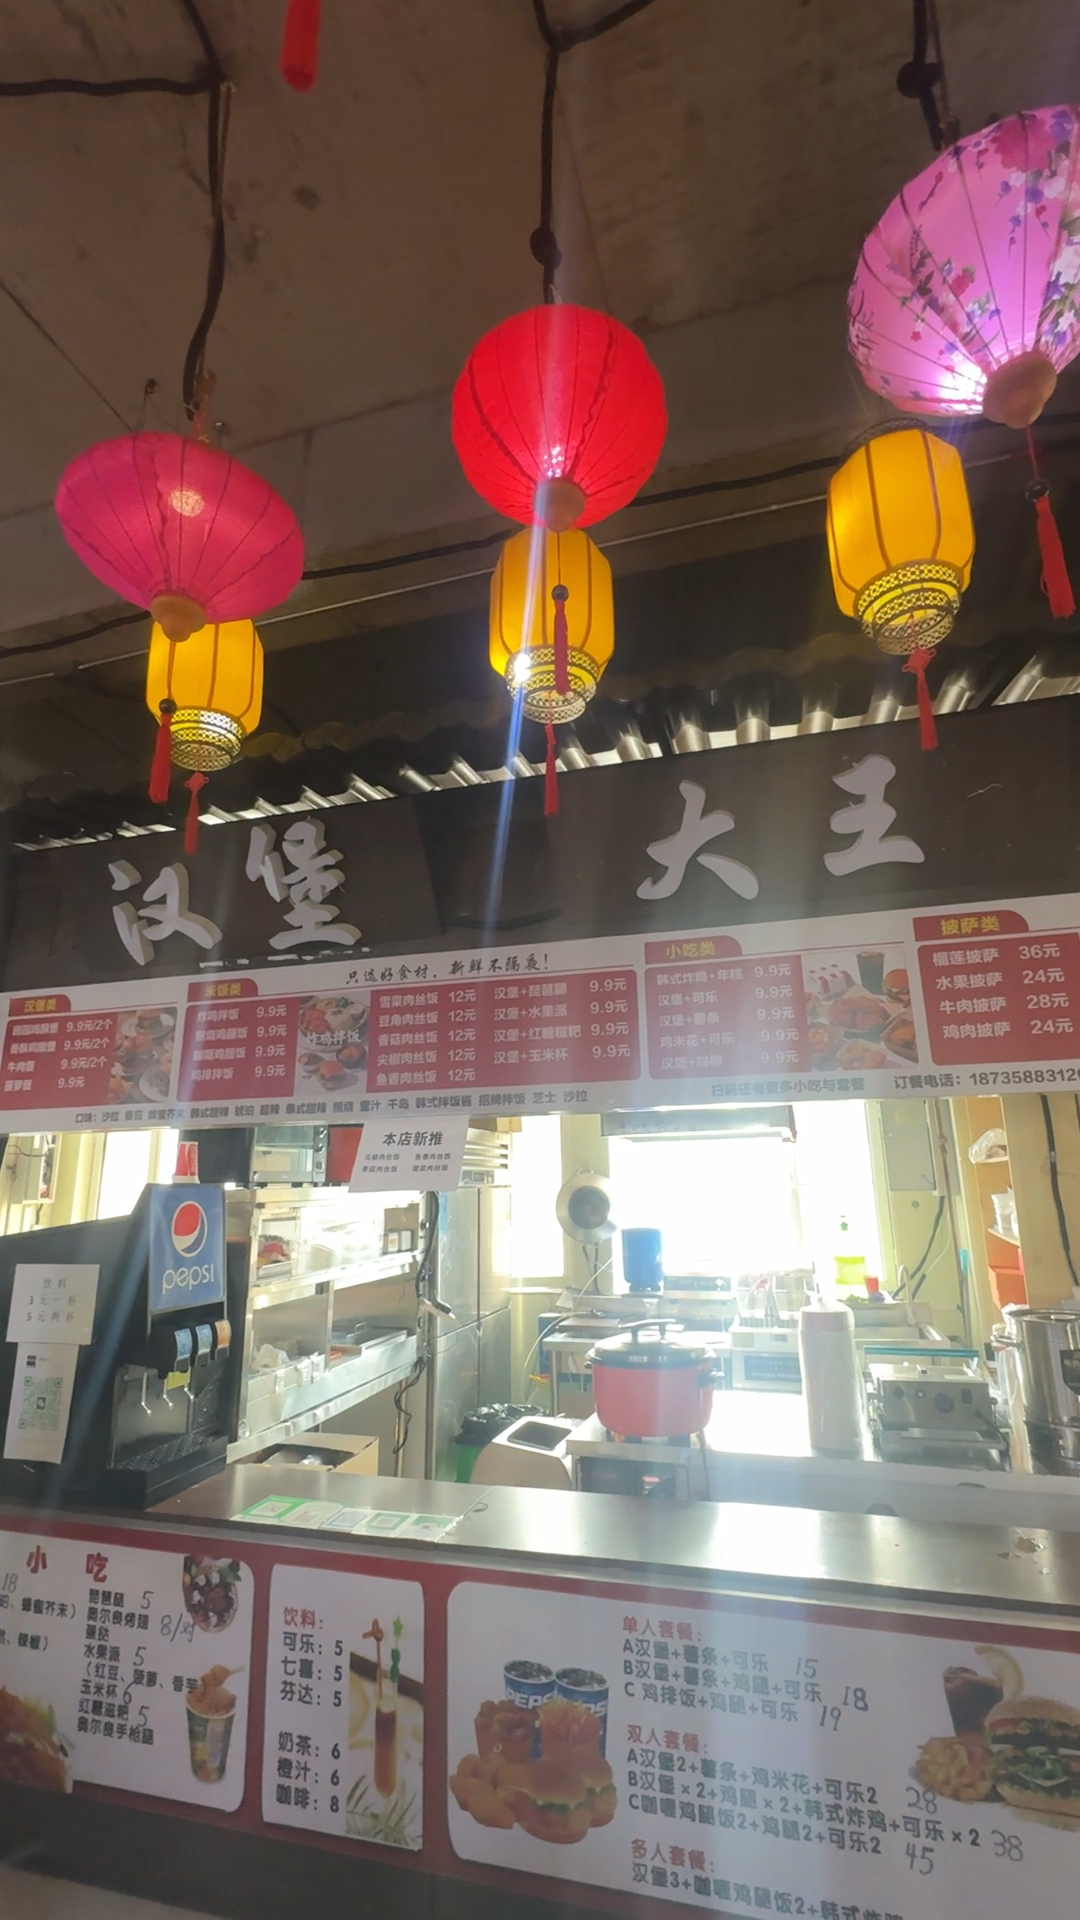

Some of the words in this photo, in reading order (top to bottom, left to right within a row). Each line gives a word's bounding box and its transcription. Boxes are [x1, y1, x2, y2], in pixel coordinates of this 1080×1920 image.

[940, 916, 1000, 936] 披萨类
[665, 941, 715, 959] 小吃类
[933, 947, 999, 967] 榴莲披萨
[1018, 943, 1061, 960] 36元
[656, 967, 744, 986] 韩式炸鸡+年糕
[754, 963, 792, 979] 9.9元
[936, 972, 1003, 991] 水果披萨
[1022, 967, 1065, 984] 24元
[205, 983, 242, 997] 米饭类
[448, 989, 477, 1003] 12元
[589, 978, 627, 993] 9.9元
[658, 991, 719, 1007] 汉堡+可乐
[755, 985, 793, 1000] 9.9元
[23, 998, 57, 1013] 汉堡类
[256, 1004, 287, 1018] 9.9元
[378, 1011, 438, 1028] 豆角肉丝饭
[448, 1009, 476, 1022] 12元
[494, 1004, 568, 1022] 汉堡+水果派
[590, 999, 628, 1015] 9.9元
[939, 996, 1007, 1015] 牛肉披萨
[1026, 992, 1070, 1010] 28元
[66, 1018, 113, 1033] 9.9元/2个
[659, 1012, 720, 1028] 汉堡+薯条
[757, 1006, 795, 1021] 9.9元
[256, 1024, 288, 1038] 9.9元
[377, 1031, 438, 1047] 香菇肉丝饭
[447, 1029, 476, 1042] 12元
[590, 1021, 629, 1037] 9.9元
[660, 1032, 735, 1049] 鸡米花+可乐
[760, 1027, 799, 1043] 9.9元
[943, 1021, 1011, 1040] 鸡肉披萨
[1030, 1018, 1074, 1035] 24元
[63, 1037, 110, 1051] 9.9元/2个
[255, 1044, 286, 1058] 9.9元
[7, 1060, 35, 1074] 牛肉堡
[60, 1056, 107, 1070] 9.9元/2个
[376, 1050, 437, 1067] 尖椒肉丝饭
[447, 1049, 476, 1062] 12元
[494, 1047, 568, 1065] 汉堡+玉米杯
[592, 1044, 631, 1059] 9.9元
[760, 1050, 799, 1065] 9.9元
[254, 1064, 286, 1078] 9.9元
[376, 1070, 437, 1087] 鱼香肉丝饭
[447, 1068, 476, 1082] 12元
[57, 1076, 86, 1089] 9.9元
[562, 1089, 588, 1103] 沙拉
[382, 1131, 444, 1147] 本店新推
[161, 1263, 216, 1294] pepsi
[2, 1572, 18, 1593] 18
[140, 1590, 155, 1610] 5
[87, 1606, 150, 1631] 奥尔良烤翅
[83, 1643, 121, 1664] 水果派
[133, 1646, 147, 1667] 5
[334, 1639, 344, 1657] 5
[622, 1637, 769, 1673] A汉堡+薯条+可乐
[333, 1665, 343, 1682] 5
[795, 1656, 819, 1679] 15
[80, 1679, 119, 1699] 玉米杯
[332, 1691, 342, 1708] 5
[842, 1685, 870, 1712] 18
[137, 1705, 150, 1728] 5
[819, 1705, 842, 1732] 19
[331, 1743, 341, 1760] 6
[330, 1769, 340, 1787] 6
[329, 1795, 340, 1814] 8
[906, 1786, 938, 1815] 28
[991, 1829, 1024, 1863] 38
[905, 1842, 935, 1876] 45
